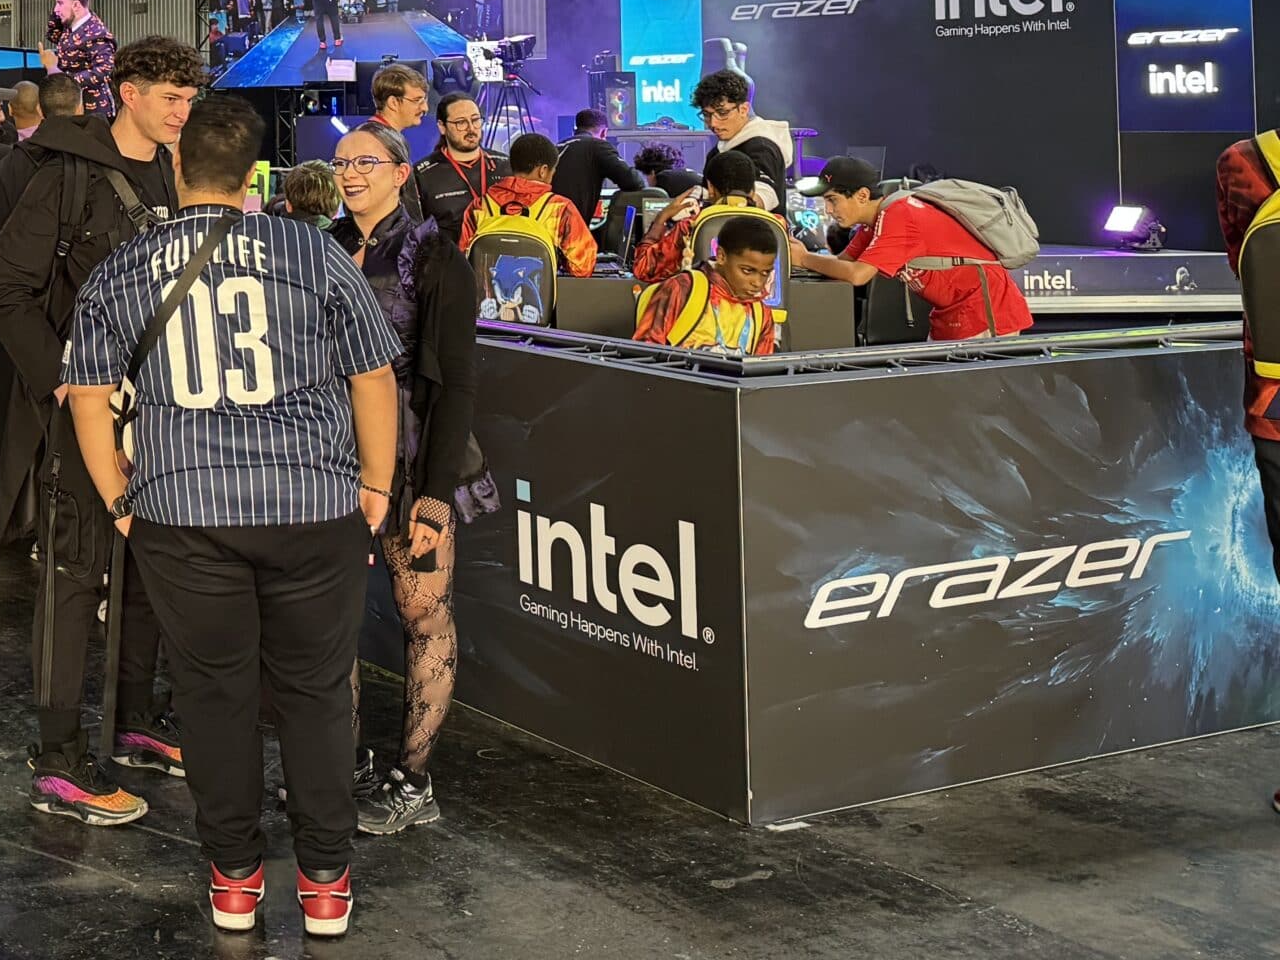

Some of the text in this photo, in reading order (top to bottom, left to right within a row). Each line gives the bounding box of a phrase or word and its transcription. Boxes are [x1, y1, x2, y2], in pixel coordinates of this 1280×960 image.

[935, 25, 973, 38] Gaming
[974, 23, 1020, 36] Happens
[1022, 20, 1046, 32] With
[1127, 27, 1240, 45] erazer
[162, 275, 276, 409] 03
[803, 530, 1192, 629] erazer
[520, 594, 568, 628] Gaming
[570, 611, 630, 647] Happens
[632, 632, 664, 659] With
